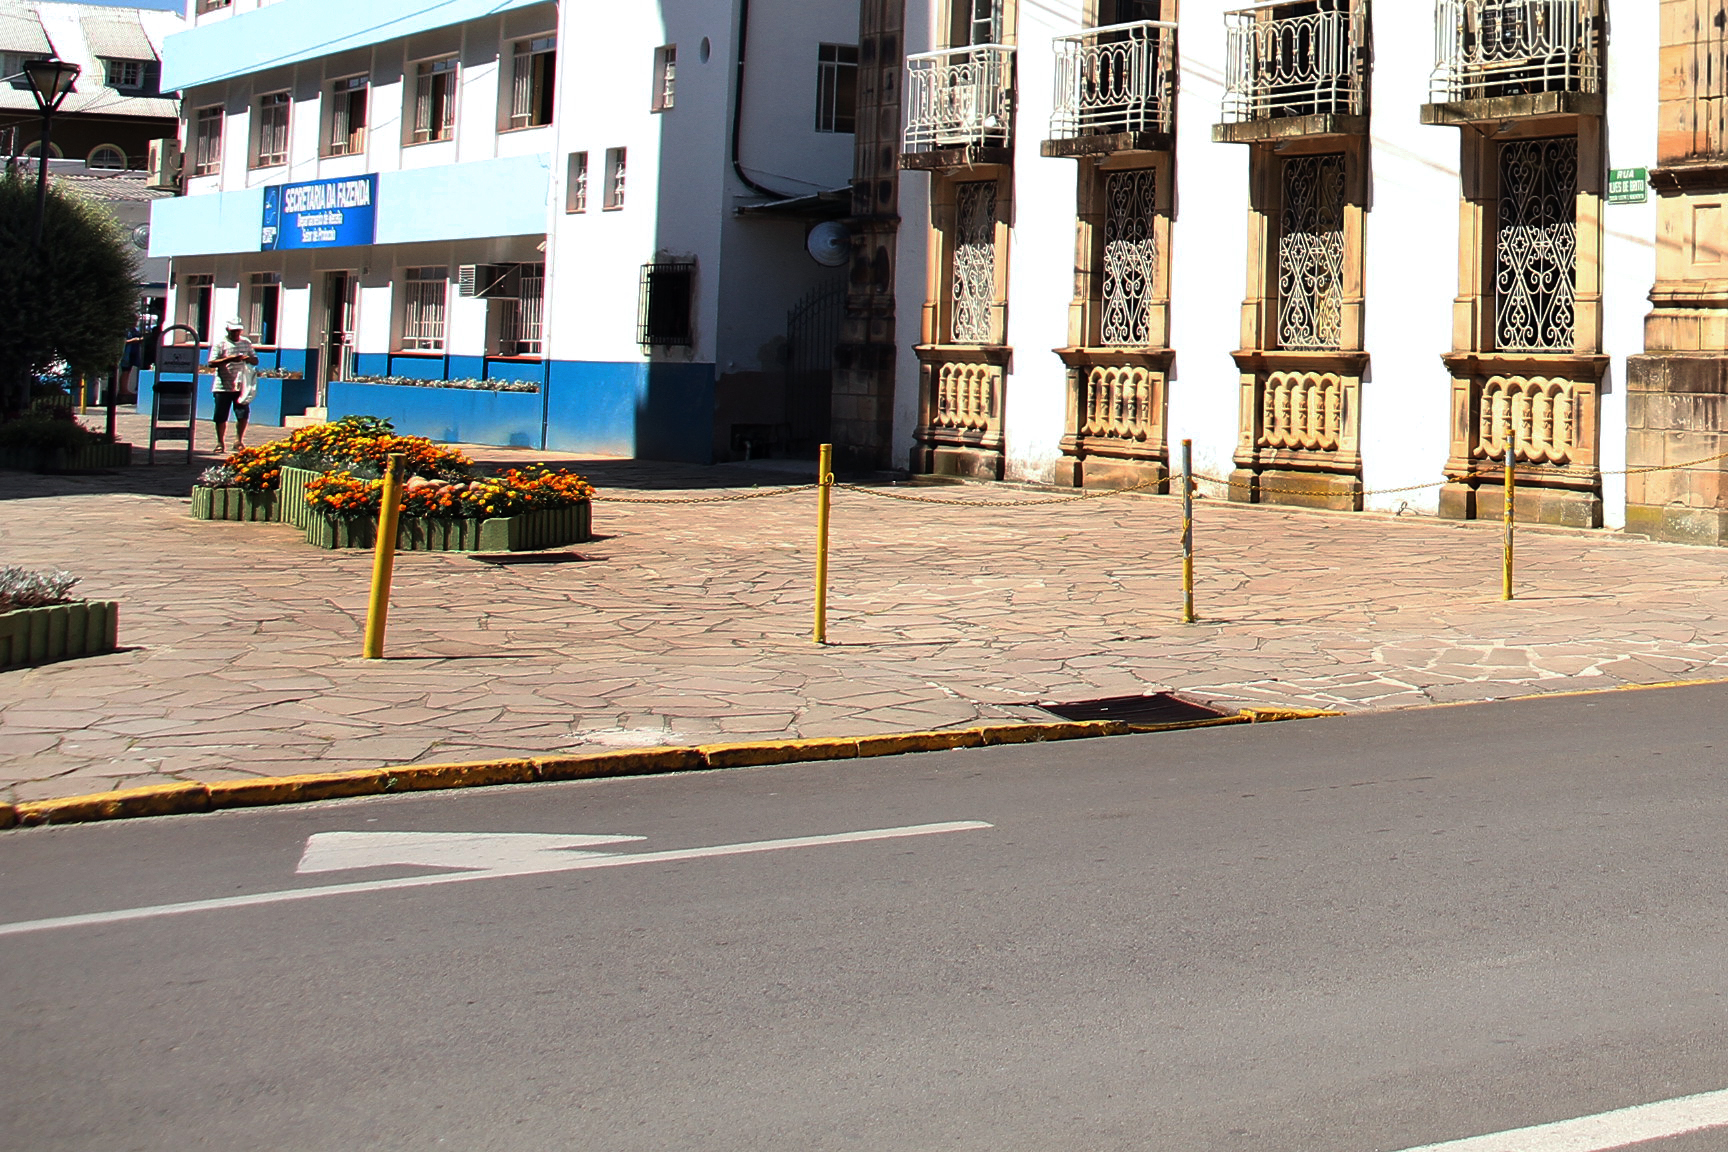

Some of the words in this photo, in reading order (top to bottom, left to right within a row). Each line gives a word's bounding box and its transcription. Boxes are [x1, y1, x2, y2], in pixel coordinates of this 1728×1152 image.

[1616, 169, 1635, 180] RUA
[1622, 180, 1629, 193] DE
[284, 184, 326, 213] SECRETARIA
[326, 183, 336, 209] DA
[337, 179, 371, 208] FAZENDA
